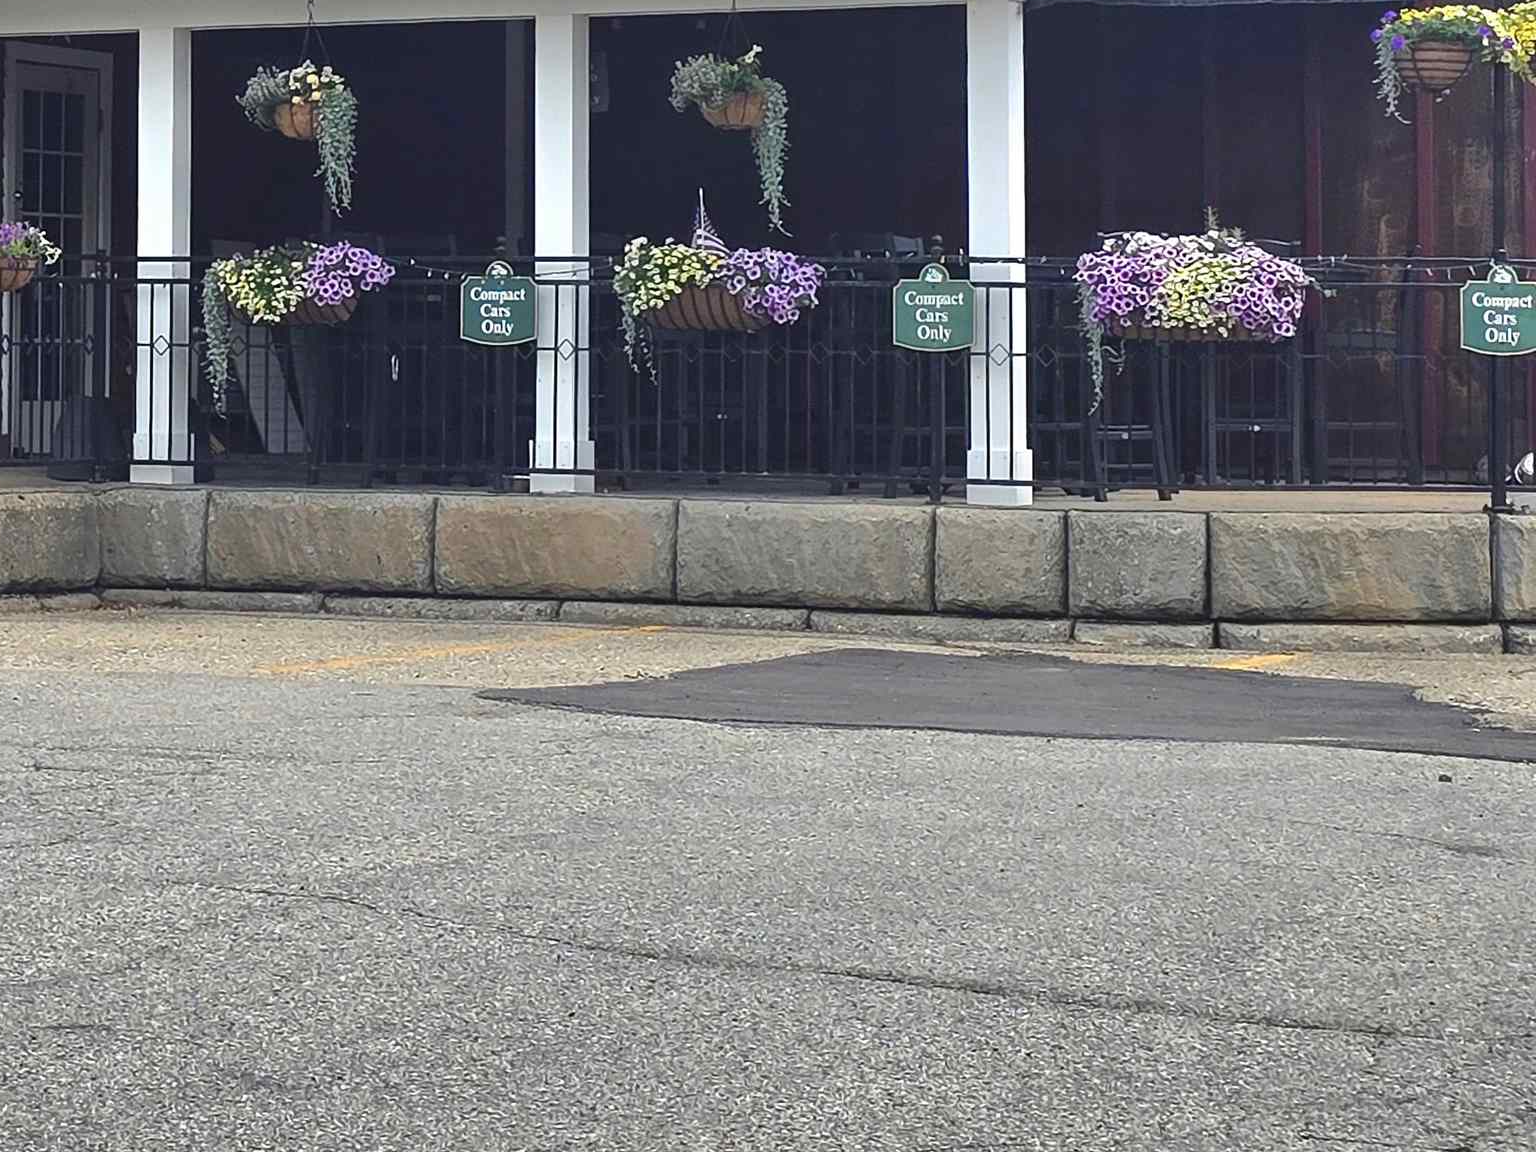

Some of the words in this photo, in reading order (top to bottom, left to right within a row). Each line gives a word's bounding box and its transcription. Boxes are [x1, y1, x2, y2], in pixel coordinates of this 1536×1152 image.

[470, 287, 526, 304] Compact
[904, 291, 964, 308] Compact
[1471, 292, 1534, 311] Compact
[480, 304, 511, 318] Cars
[915, 308, 949, 323] Cars
[1483, 310, 1518, 326] Cars
[481, 319, 514, 336] Only
[917, 325, 952, 343] Only
[1485, 328, 1521, 347] Only
